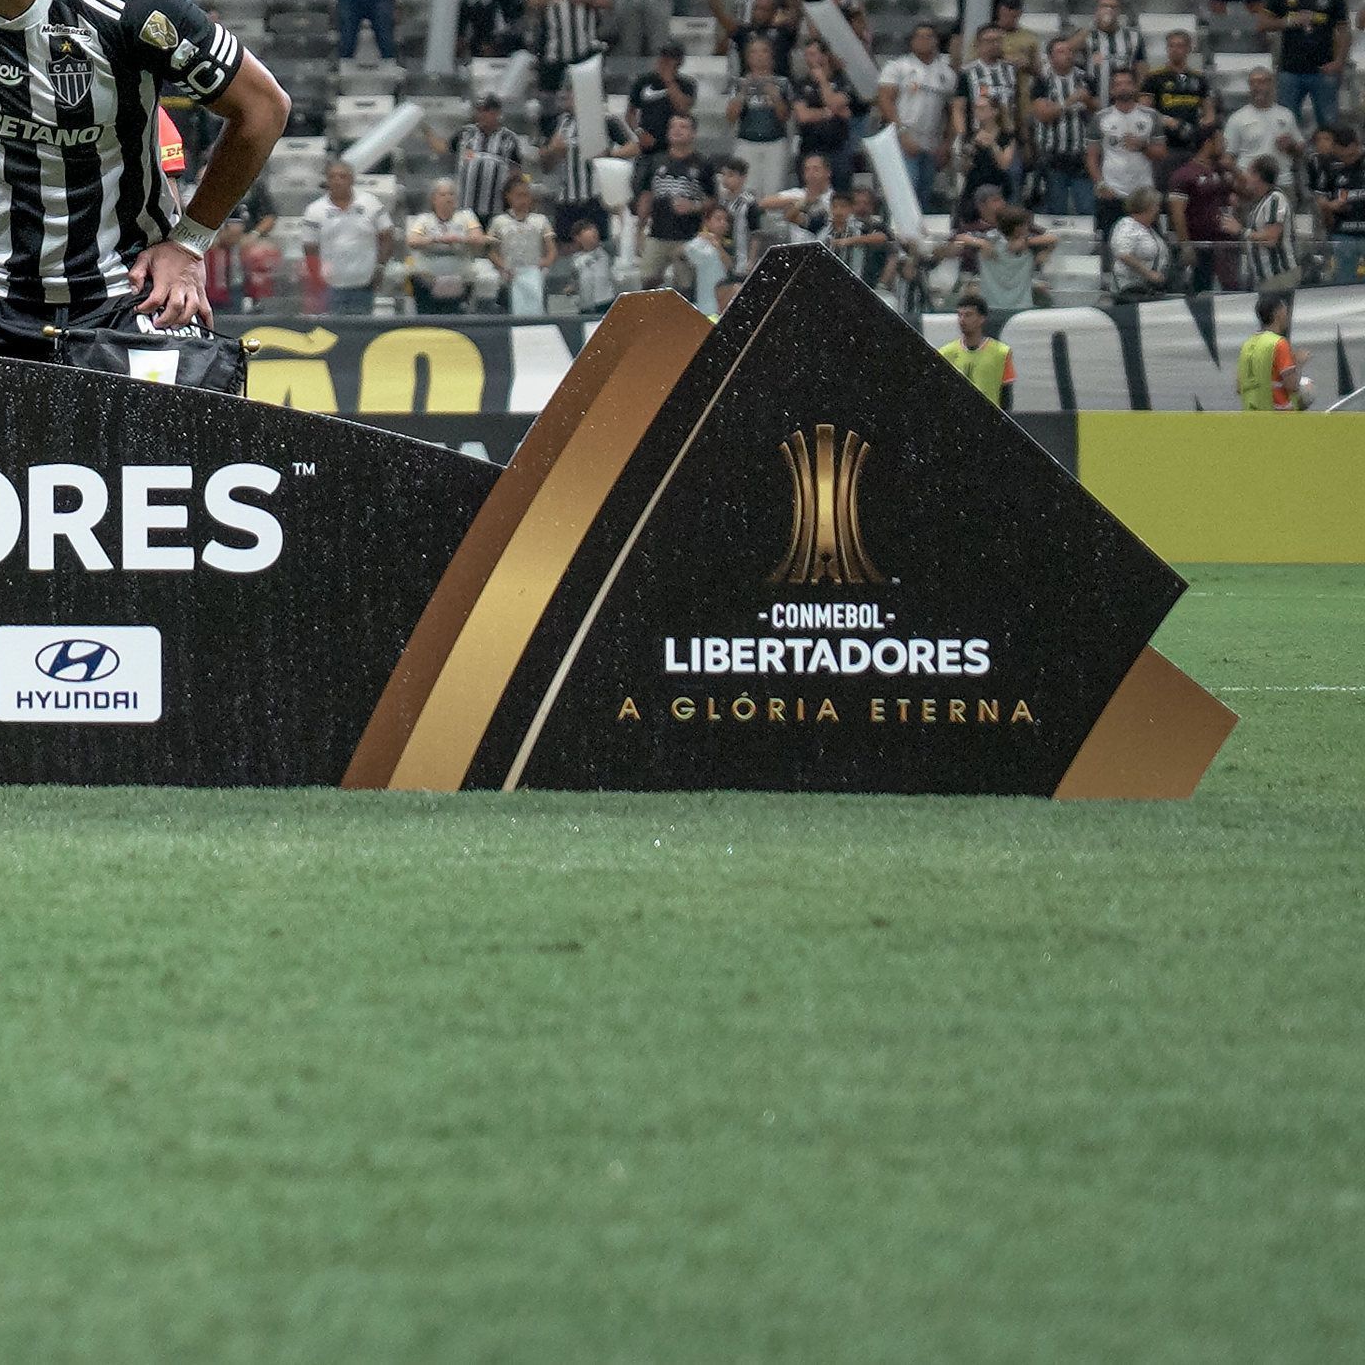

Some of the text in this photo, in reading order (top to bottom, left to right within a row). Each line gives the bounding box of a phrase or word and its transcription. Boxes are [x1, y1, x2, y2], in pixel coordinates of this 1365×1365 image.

[51, 62, 90, 74] CAM
[187, 60, 226, 95] C
[664, 637, 991, 675] LIBERTADORES
[16, 690, 139, 711] HYUNDAI
[617, 691, 1035, 724] A GLÓRIA ETERNA
